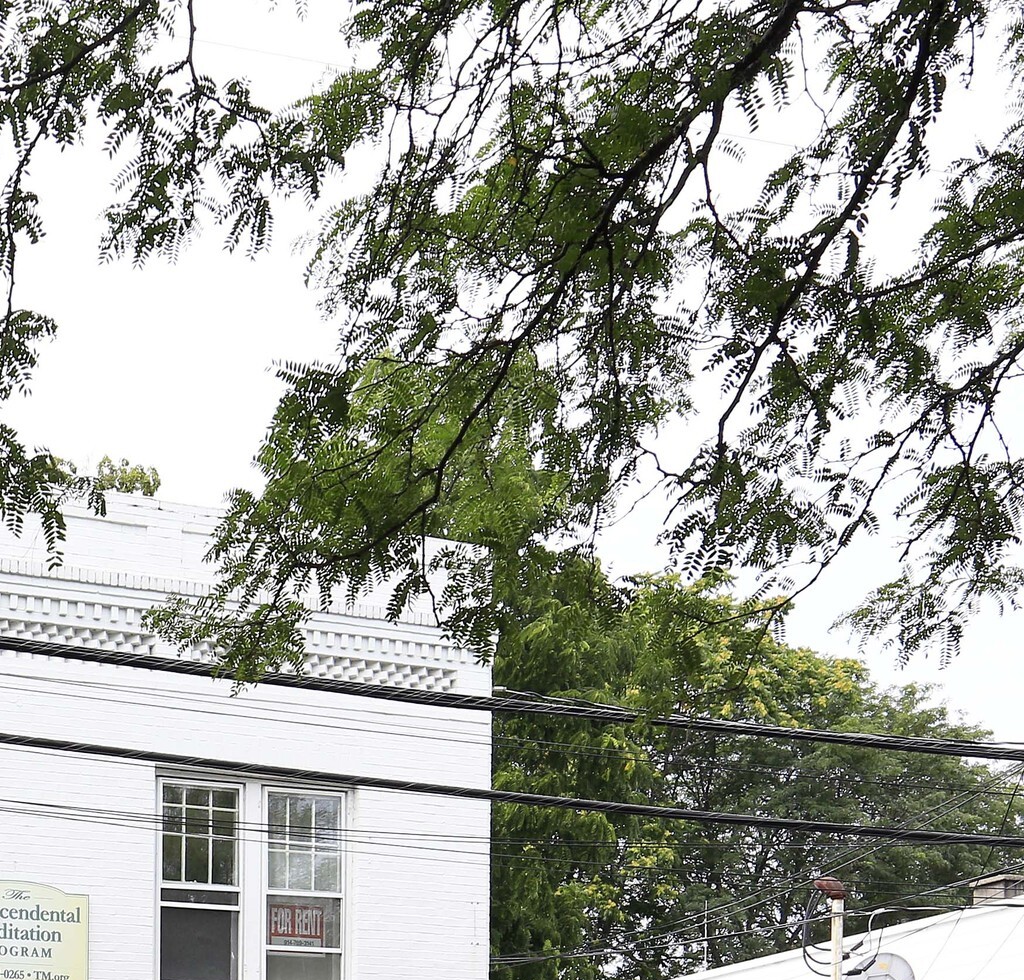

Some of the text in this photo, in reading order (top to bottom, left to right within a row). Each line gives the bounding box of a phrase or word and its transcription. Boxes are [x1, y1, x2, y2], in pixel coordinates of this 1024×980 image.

[2, 888, 31, 900] The
[271, 907, 322, 936] FOR RENT
